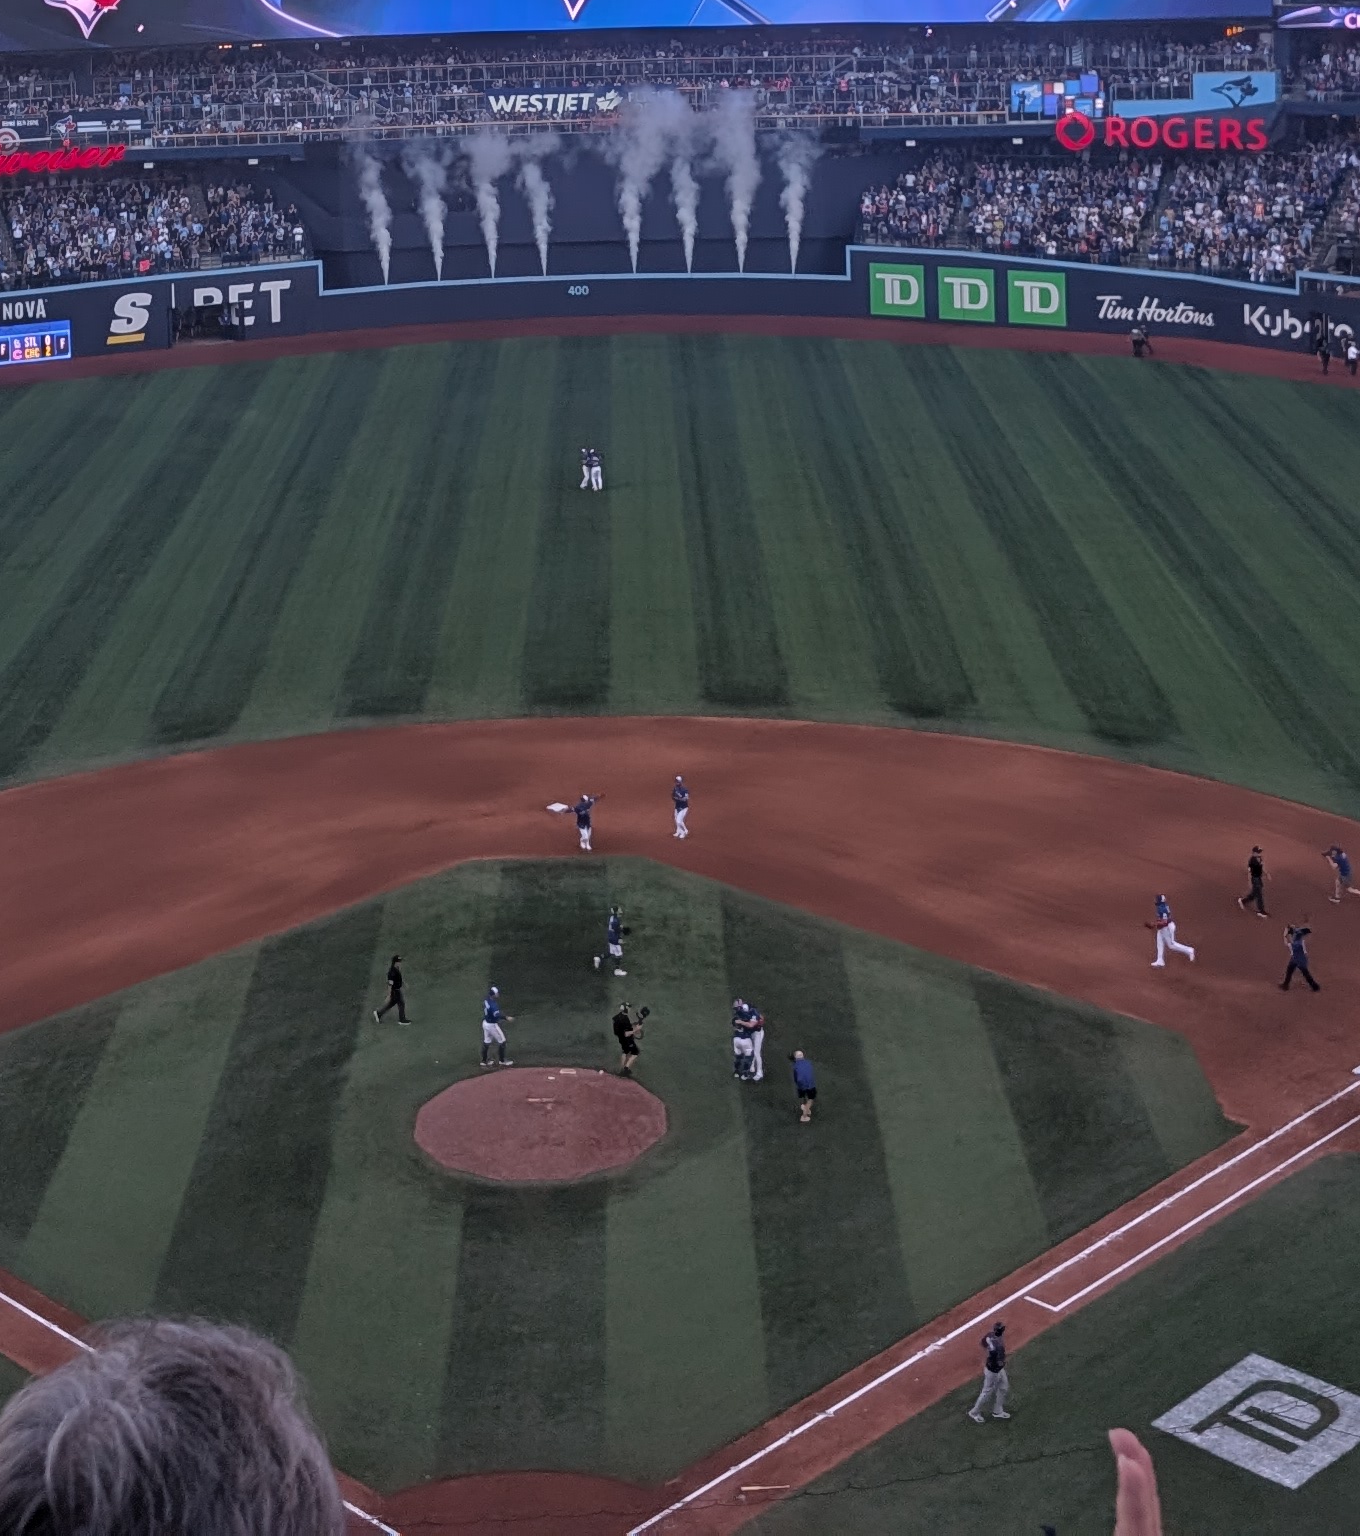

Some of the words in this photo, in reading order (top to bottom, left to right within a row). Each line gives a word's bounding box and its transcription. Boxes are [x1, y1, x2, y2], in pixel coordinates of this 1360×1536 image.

[1104, 116, 1269, 151] ROGERS
[568, 284, 590, 297] 400
[875, 273, 919, 305] TD
[944, 277, 988, 309] TD
[1014, 281, 1059, 314] TD
[2, 298, 47, 322] NOVA
[110, 292, 152, 334] S
[1096, 295, 1133, 321] Tim
[1137, 296, 1215, 327] Hortons
[24, 336, 38, 347] STL
[1191, 1380, 1340, 1451] TD
